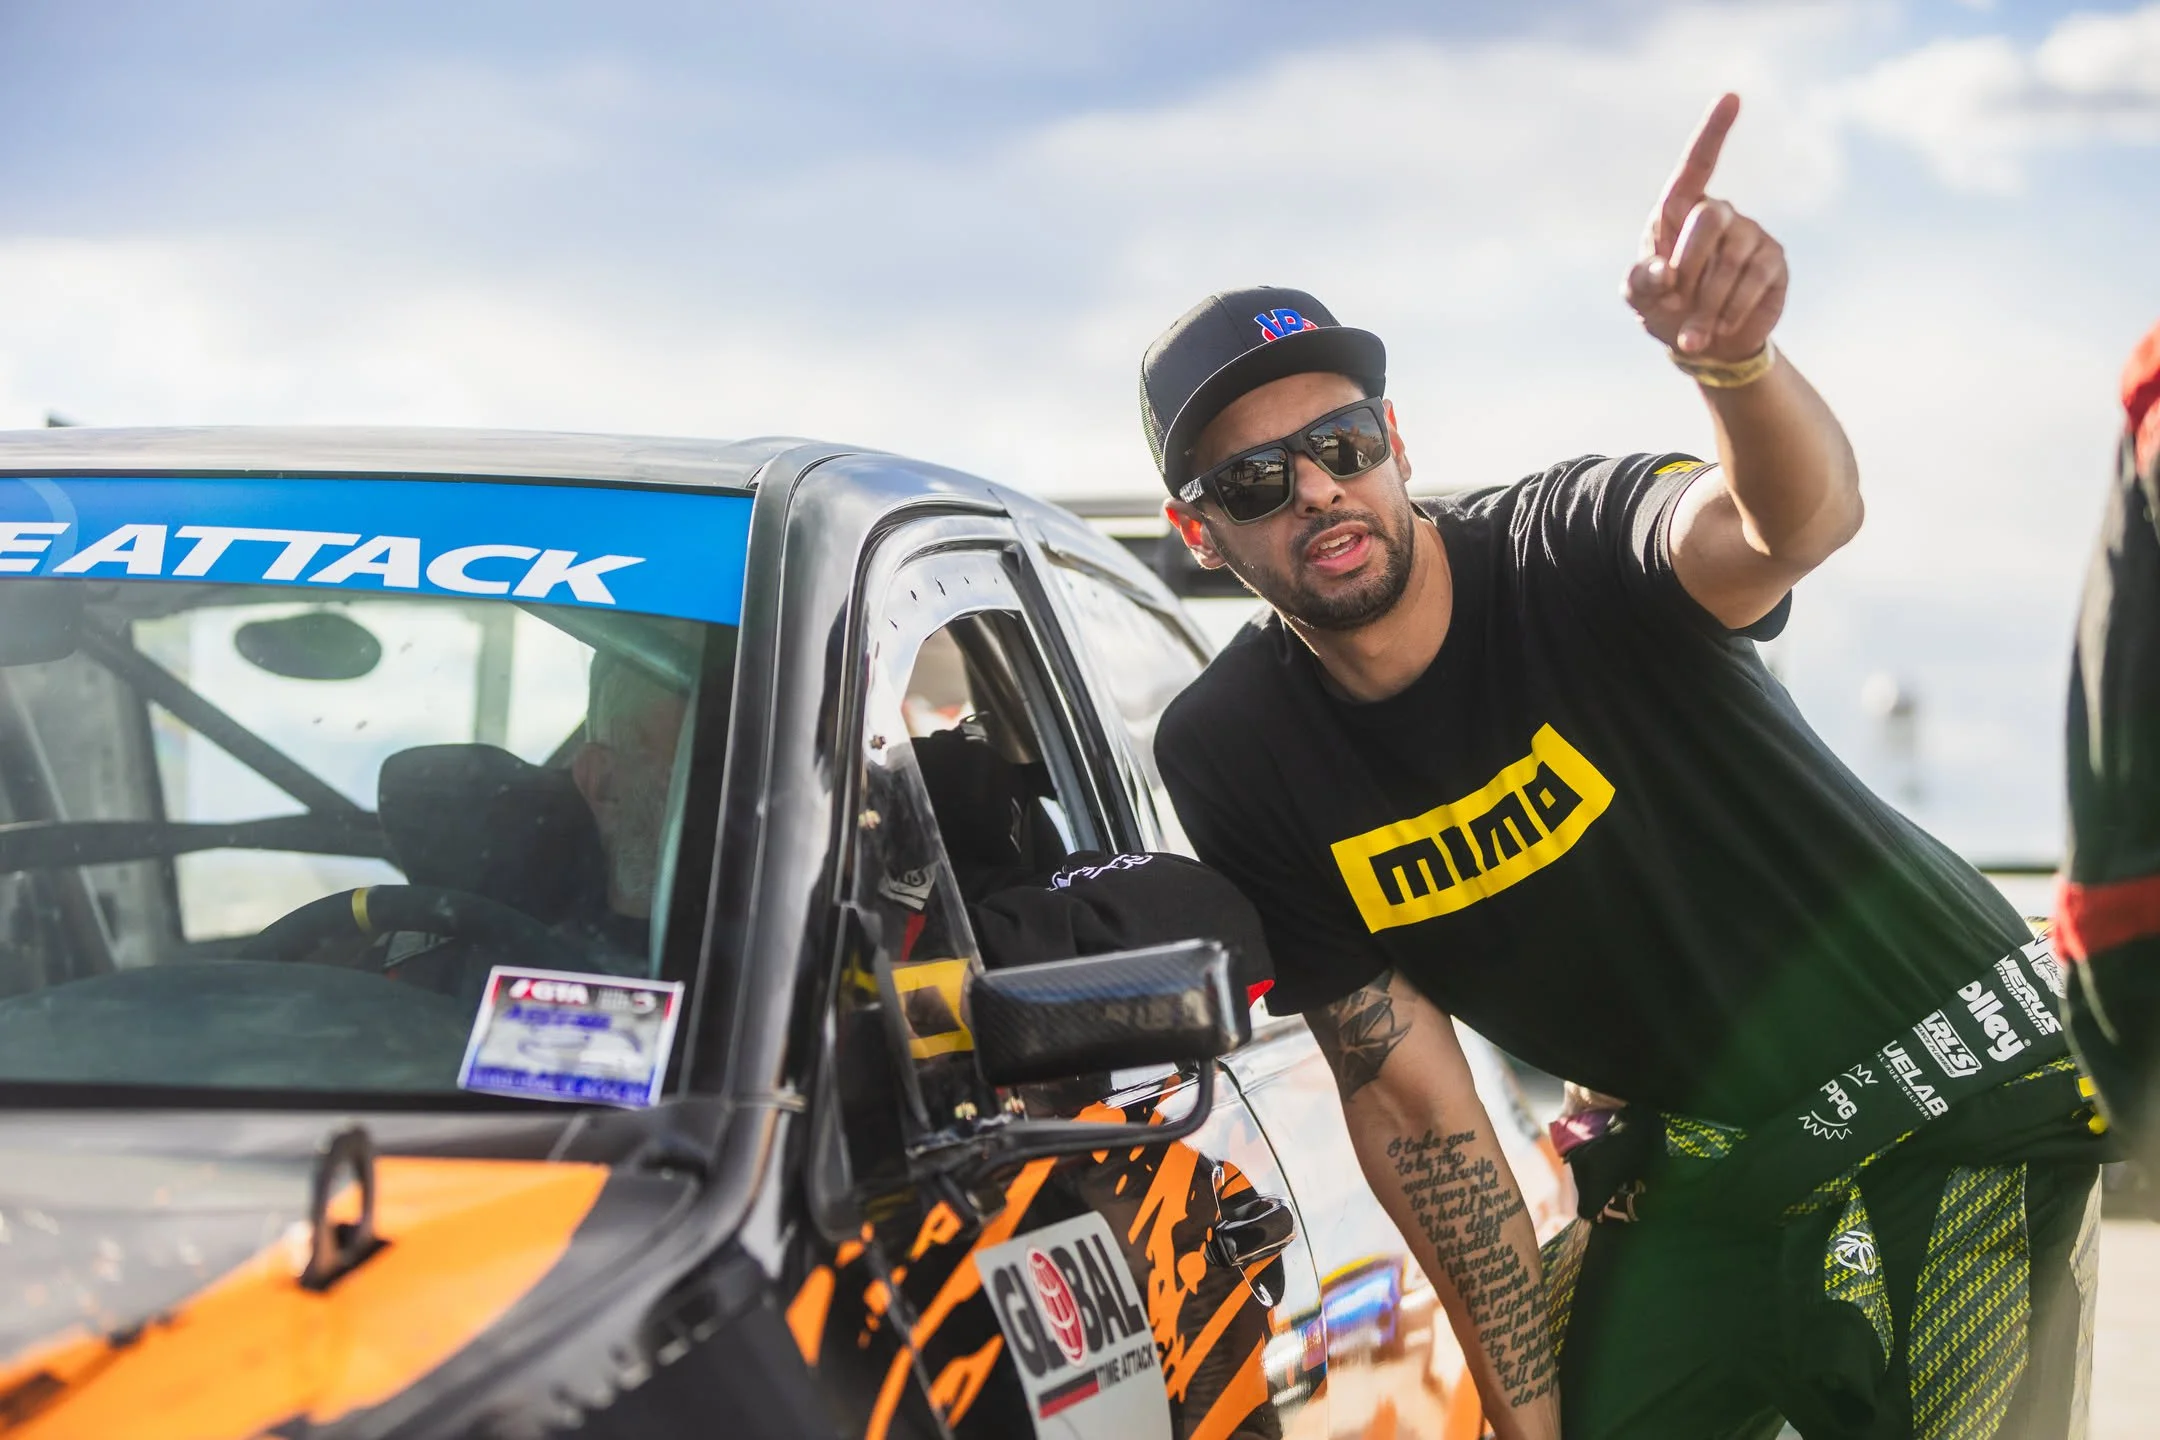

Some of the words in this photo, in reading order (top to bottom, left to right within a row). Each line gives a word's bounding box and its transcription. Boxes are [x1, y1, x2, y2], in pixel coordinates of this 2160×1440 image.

[1254, 308, 1305, 339] VP
[53, 524, 646, 605] ATTACK
[1819, 1079, 1858, 1121] PPG
[1885, 1064, 1902, 1084] FUEL
[1902, 1085, 1932, 1120] DELIVERY
[1404, 1128, 1440, 1154] take
[1443, 1130, 1476, 1154] you
[1395, 1156, 1413, 1176] to
[1415, 1152, 1432, 1171] be
[1402, 1165, 1459, 1195] wedded
[1459, 1156, 1494, 1183] wife
[1410, 1192, 1428, 1211] to
[1430, 1187, 1467, 1206] have
[1469, 1170, 1499, 1195] and
[1418, 1211, 1434, 1228] to
[1436, 1196, 1474, 1222] hold
[1426, 1223, 1457, 1244] this
[992, 1233, 1146, 1378] GLOBAL
[1480, 1315, 1513, 1343] and
[1121, 1343, 1154, 1378] ATTACK
[1486, 1340, 1506, 1359] to
[1493, 1358, 1515, 1375] to
[1511, 1387, 1535, 1408] do
